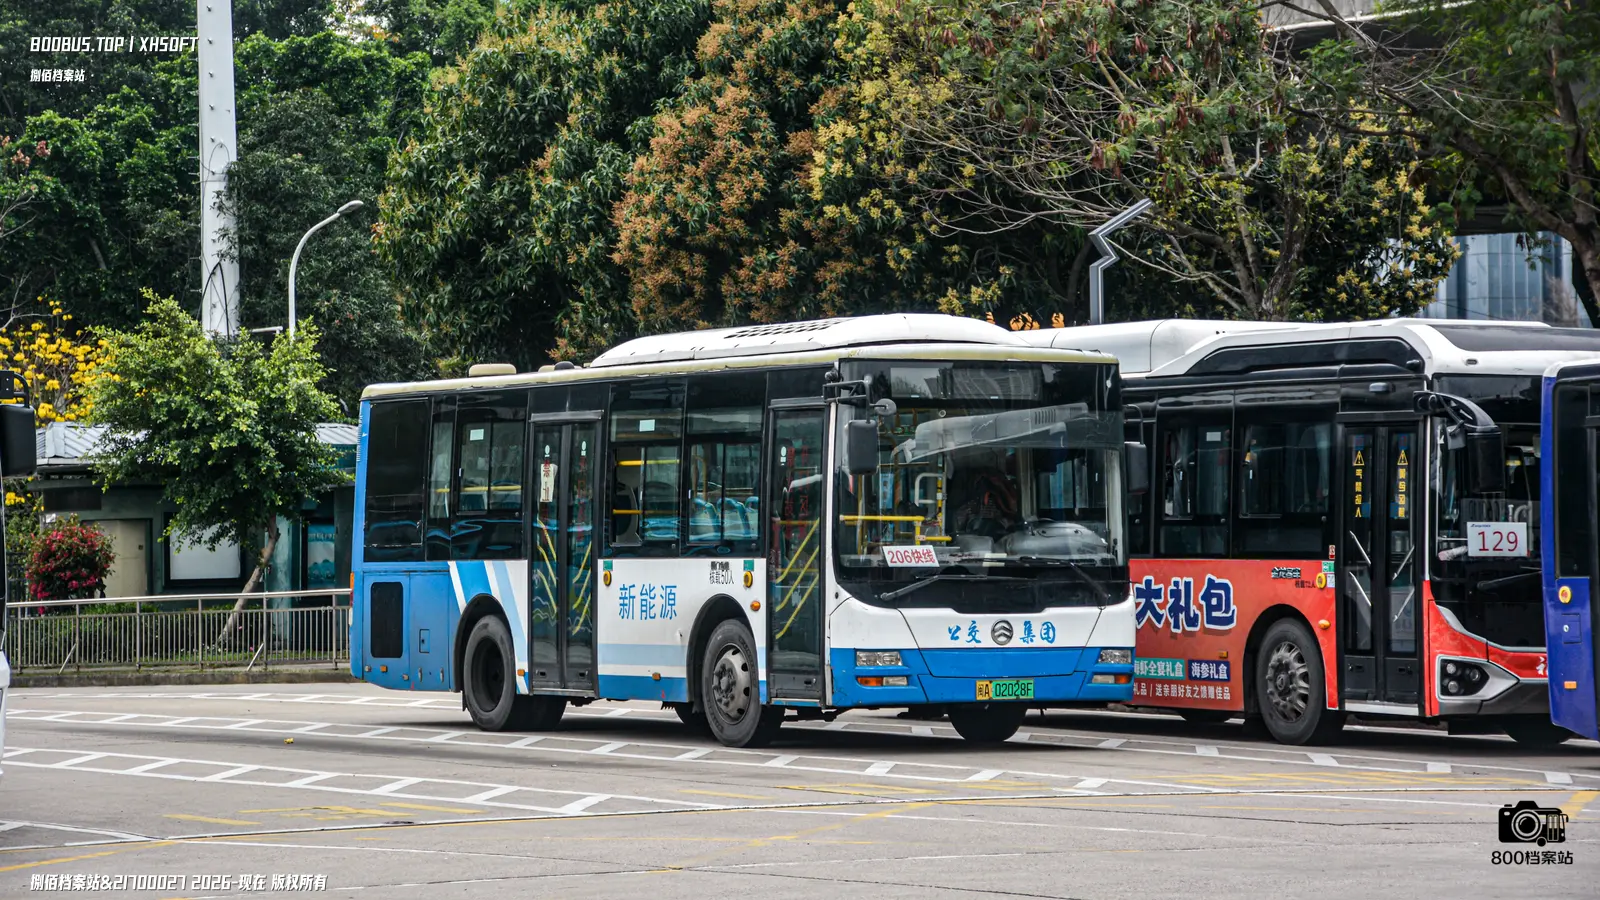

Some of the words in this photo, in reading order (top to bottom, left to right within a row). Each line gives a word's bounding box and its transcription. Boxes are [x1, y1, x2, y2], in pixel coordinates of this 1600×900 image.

[1478, 531, 1519, 552] 129
[887, 549, 937, 565] 206快线
[709, 569, 735, 585] 核载50人
[619, 583, 678, 621] 新能源
[1134, 573, 1237, 633] 大礼包
[947, 620, 983, 644] 公交
[1019, 620, 1056, 645] 集团
[1191, 662, 1229, 680] 海参礼盒
